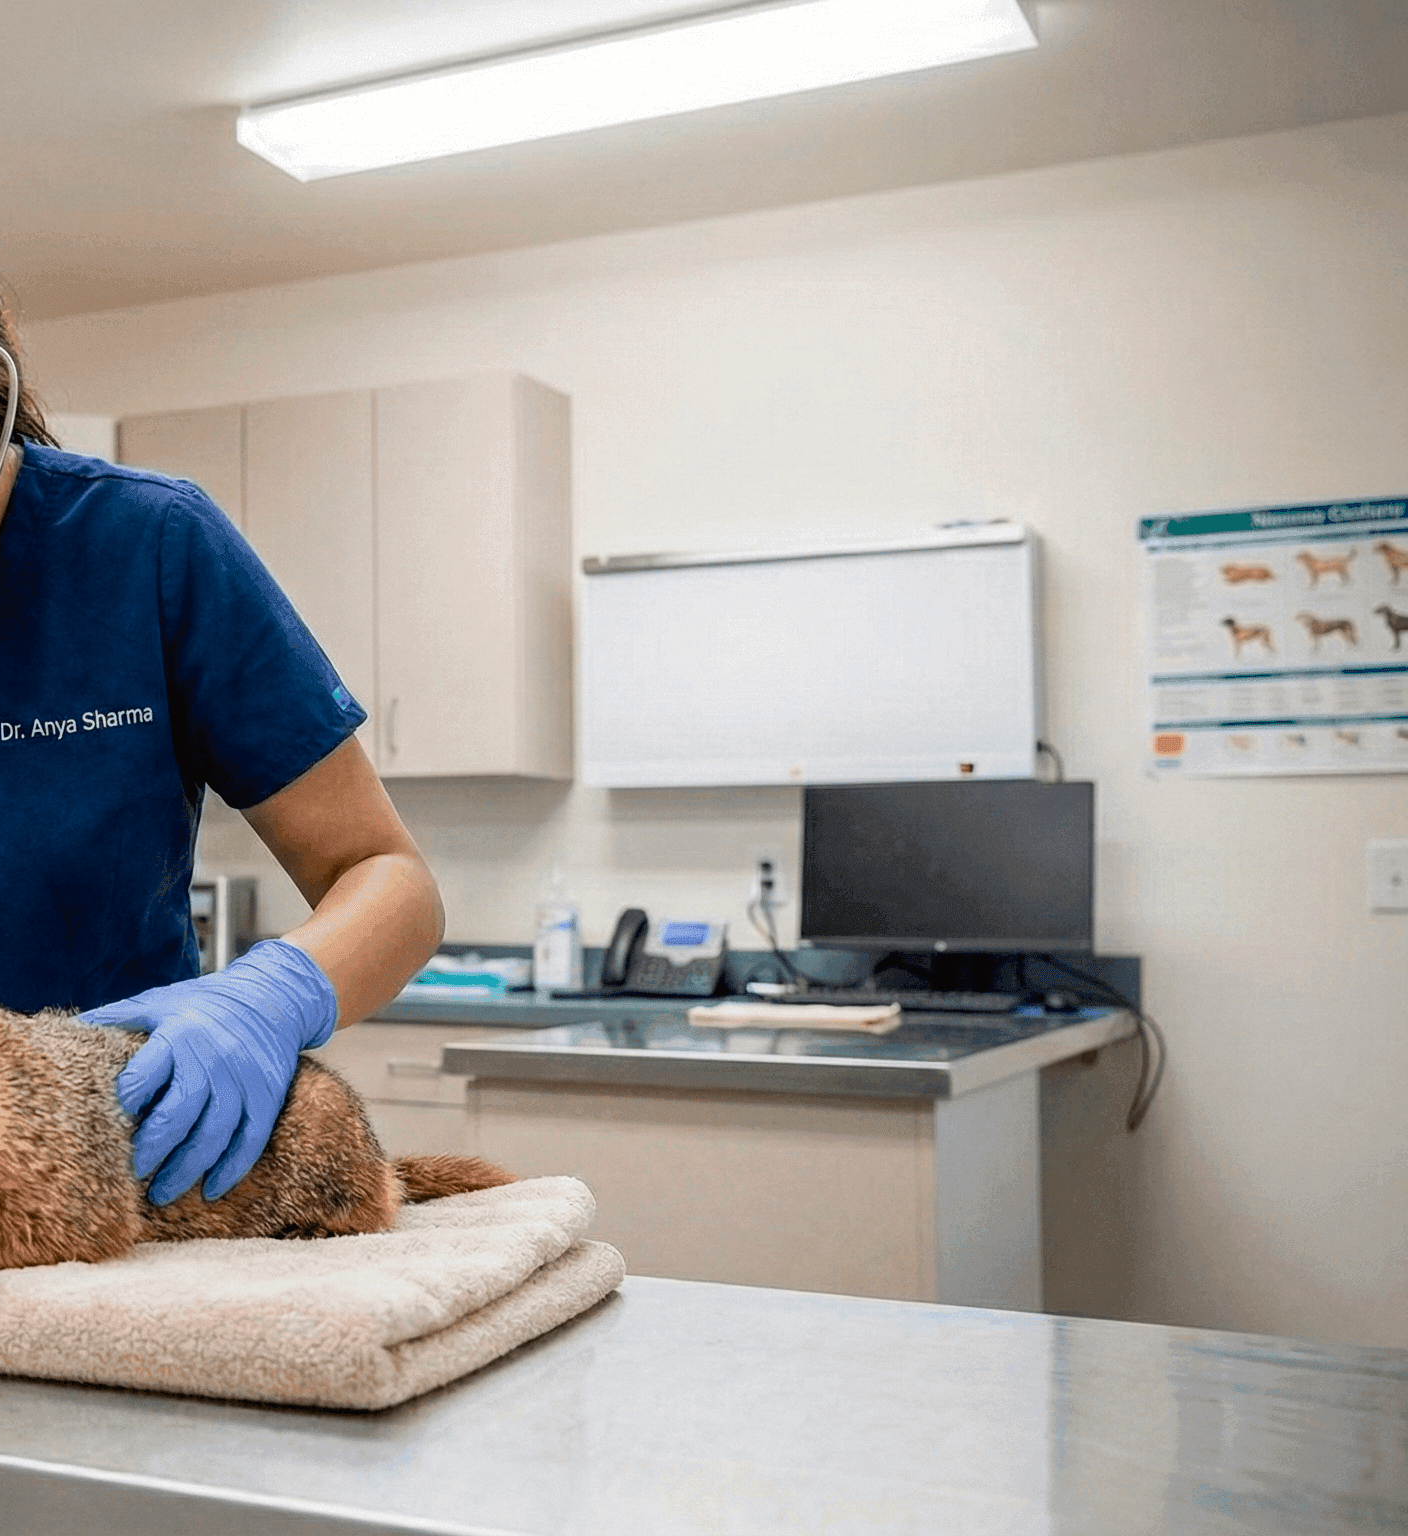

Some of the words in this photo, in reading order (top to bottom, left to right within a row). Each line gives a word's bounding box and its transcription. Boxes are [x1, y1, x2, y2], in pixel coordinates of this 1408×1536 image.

[0, 722, 25, 741] Dr.
[31, 718, 77, 740] Anya
[82, 706, 153, 731] Sharma
